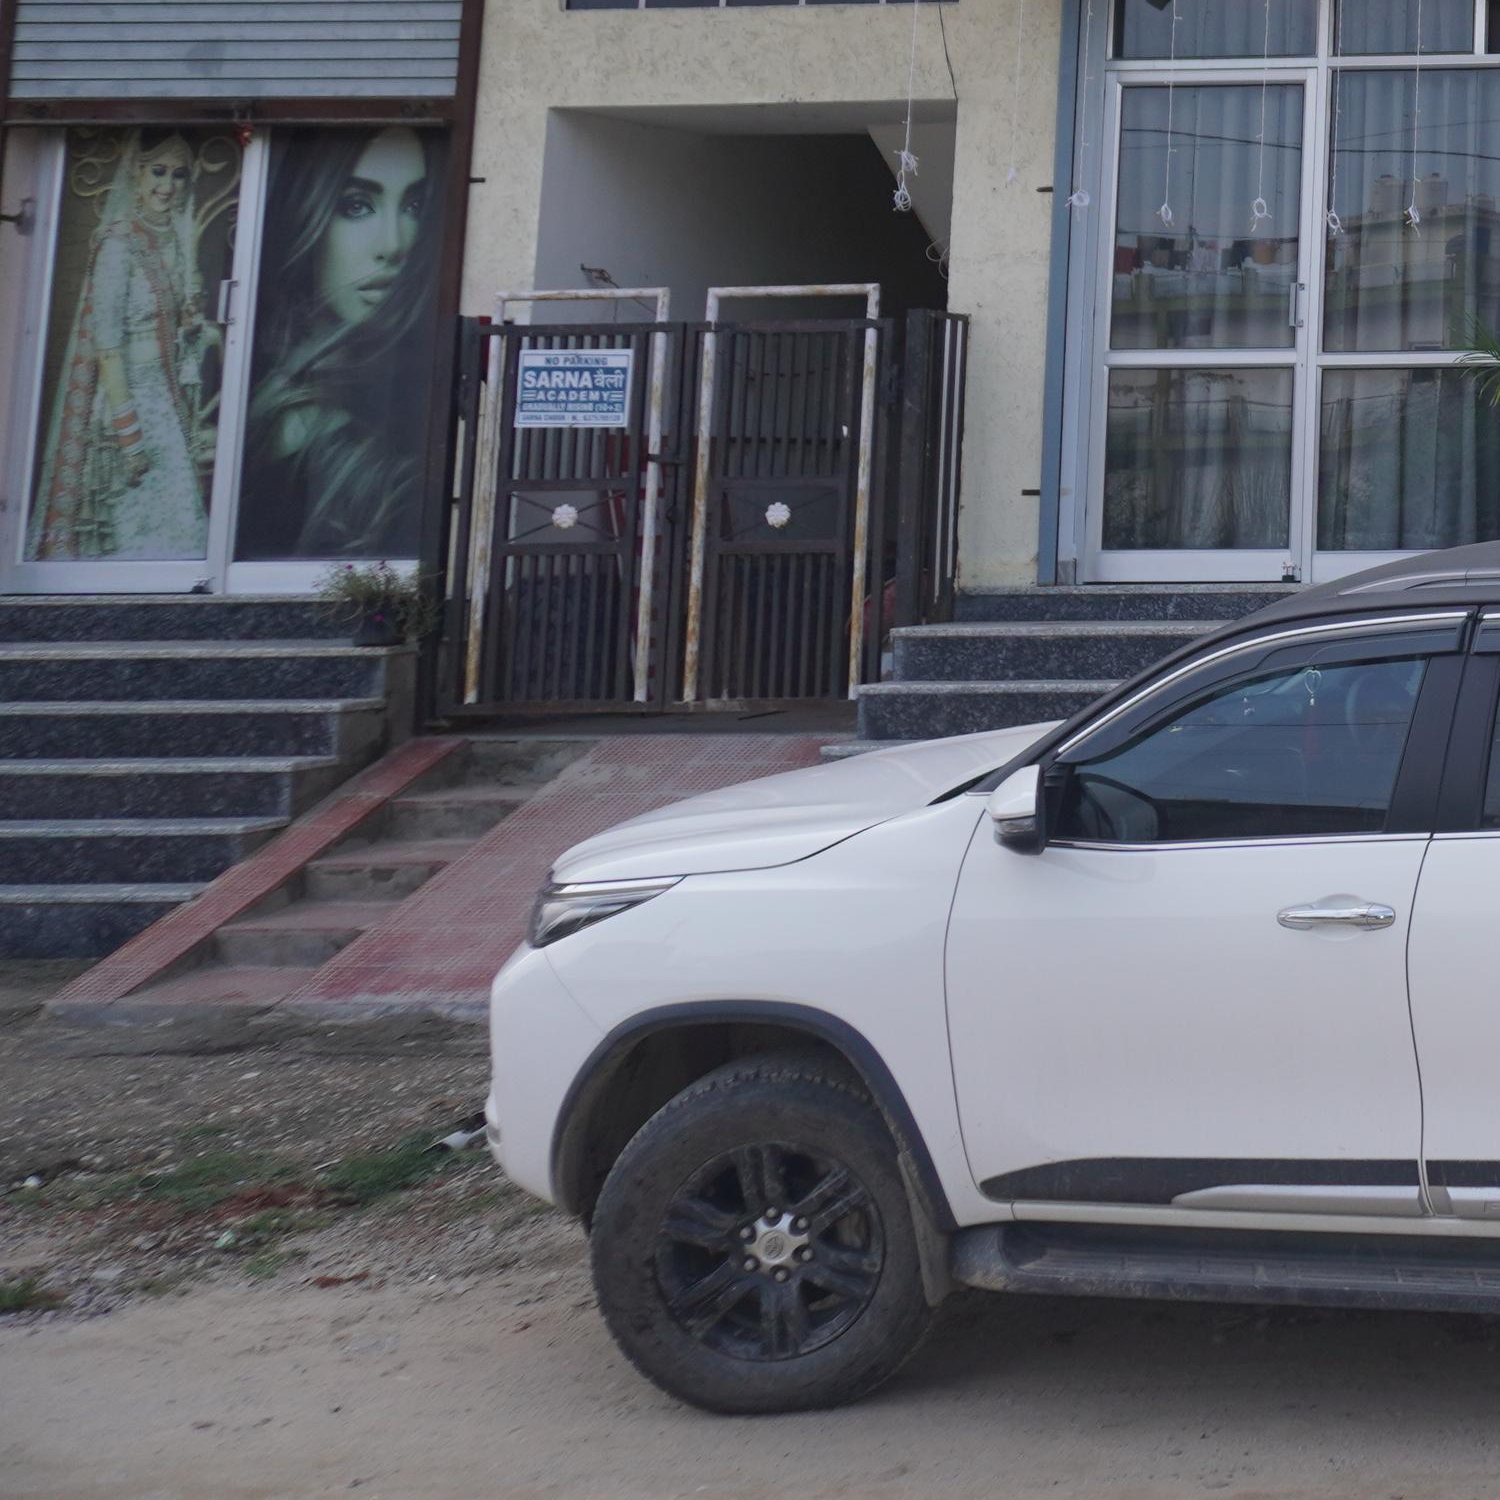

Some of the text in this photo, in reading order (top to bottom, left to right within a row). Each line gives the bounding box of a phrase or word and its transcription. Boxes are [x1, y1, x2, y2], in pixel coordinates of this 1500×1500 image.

[544, 356, 608, 366] NO PARKING
[523, 370, 593, 388] SARNA
[536, 390, 611, 401] ACADEMY
